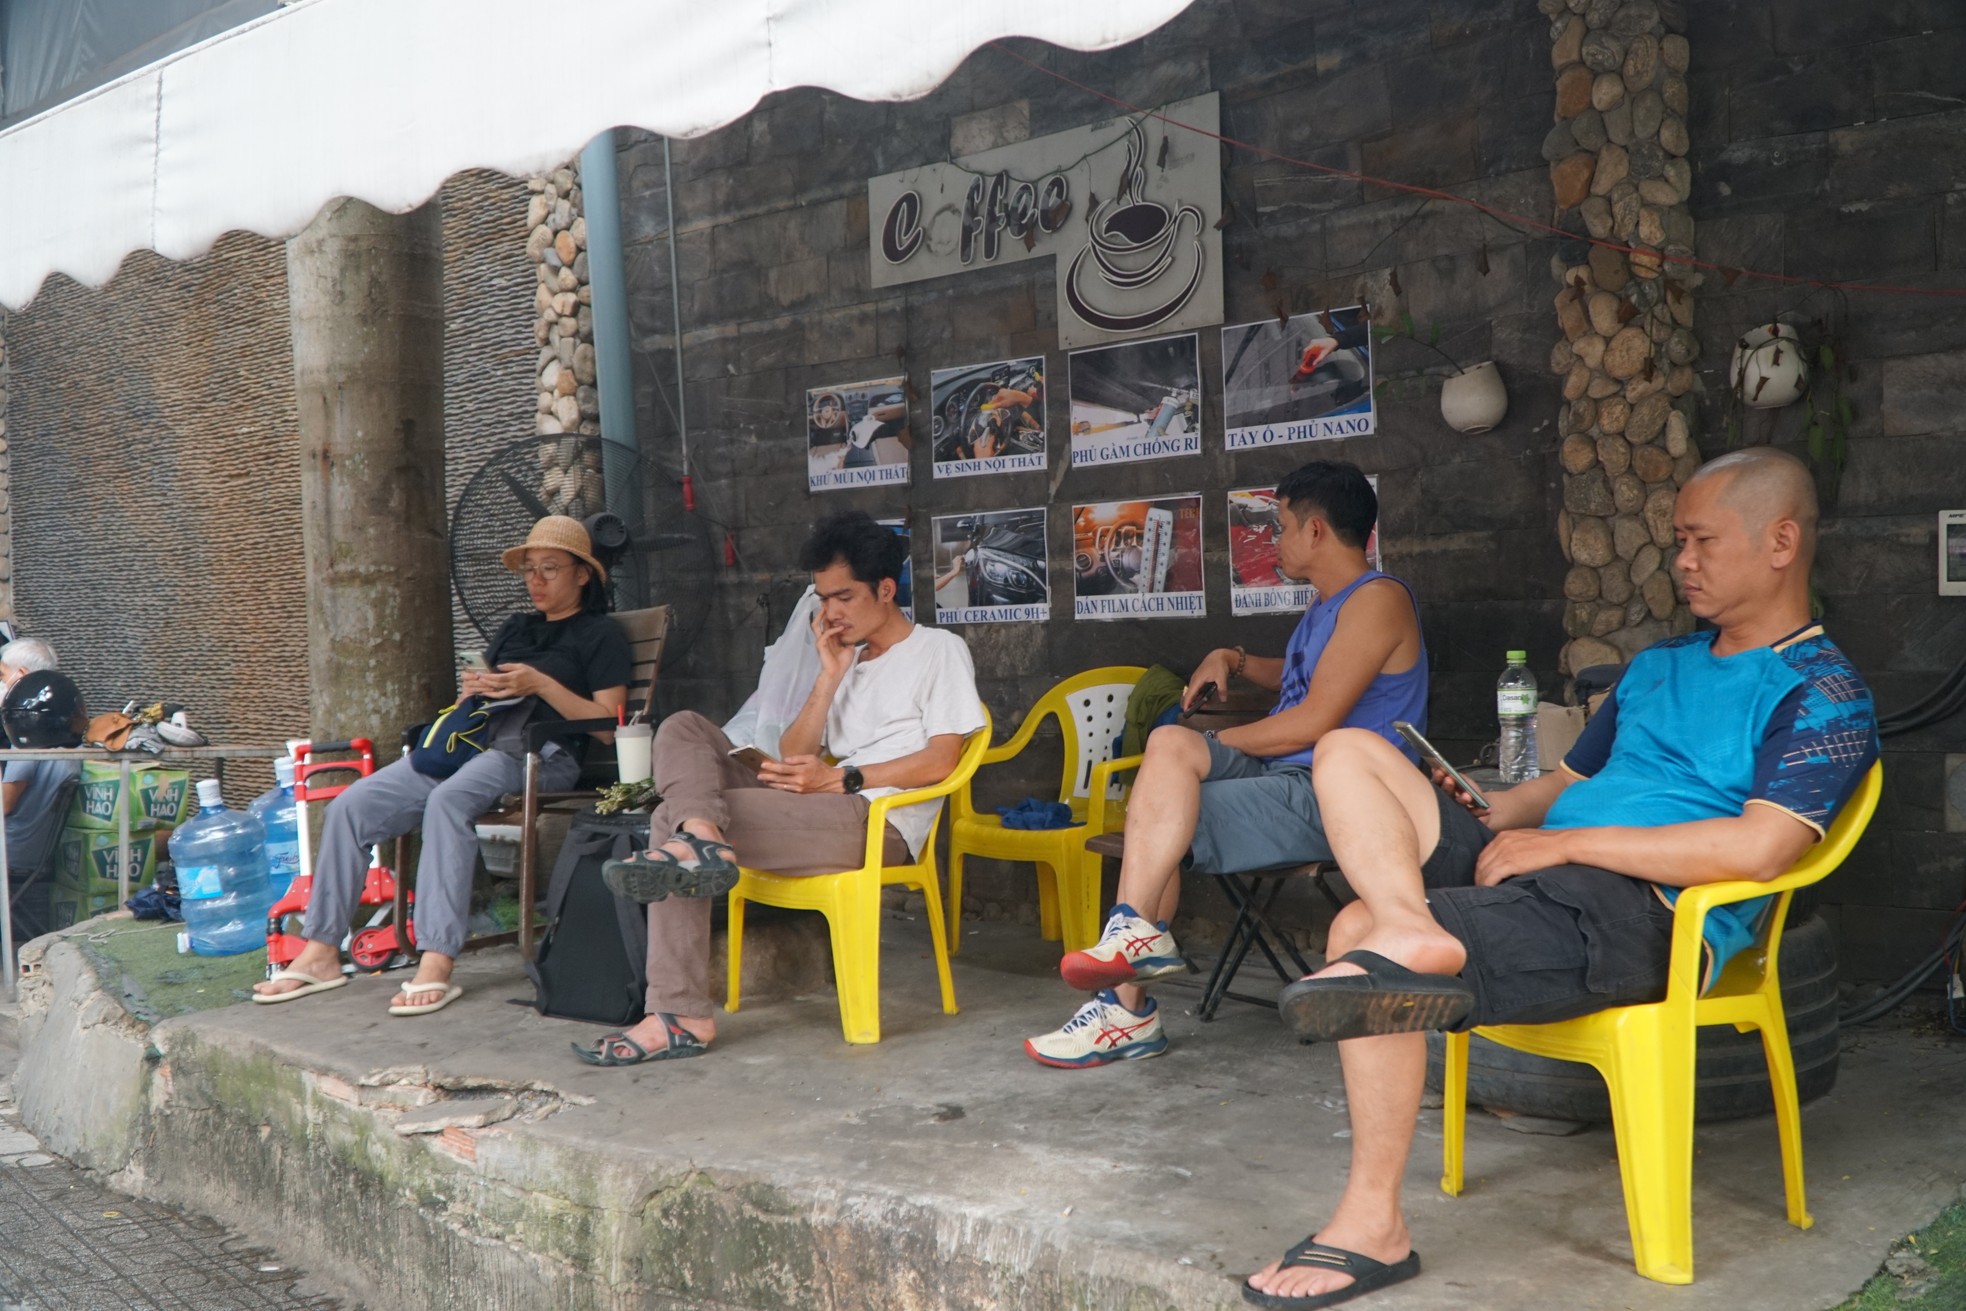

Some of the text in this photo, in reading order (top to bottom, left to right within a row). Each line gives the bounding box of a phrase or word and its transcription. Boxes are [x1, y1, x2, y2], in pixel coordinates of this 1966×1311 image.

[1287, 420, 1318, 441] PHỦ
[1322, 417, 1370, 437] NANO
[1072, 444, 1097, 464] PHỦ
[1133, 437, 1181, 457] CHỐNG
[954, 461, 981, 473] SINH
[984, 457, 1005, 472] NỘI
[1008, 453, 1044, 468] THẤT
[856, 468, 876, 484] NỘI
[878, 465, 907, 481] THẤT
[1076, 593, 1204, 615] DÁN FILM CÁCH NHIỆT
[1234, 589, 1262, 609] ĐÁNH
[1264, 588, 1291, 608] BÓNG
[939, 606, 1048, 623] PHỦ CERAMIC 9H+
